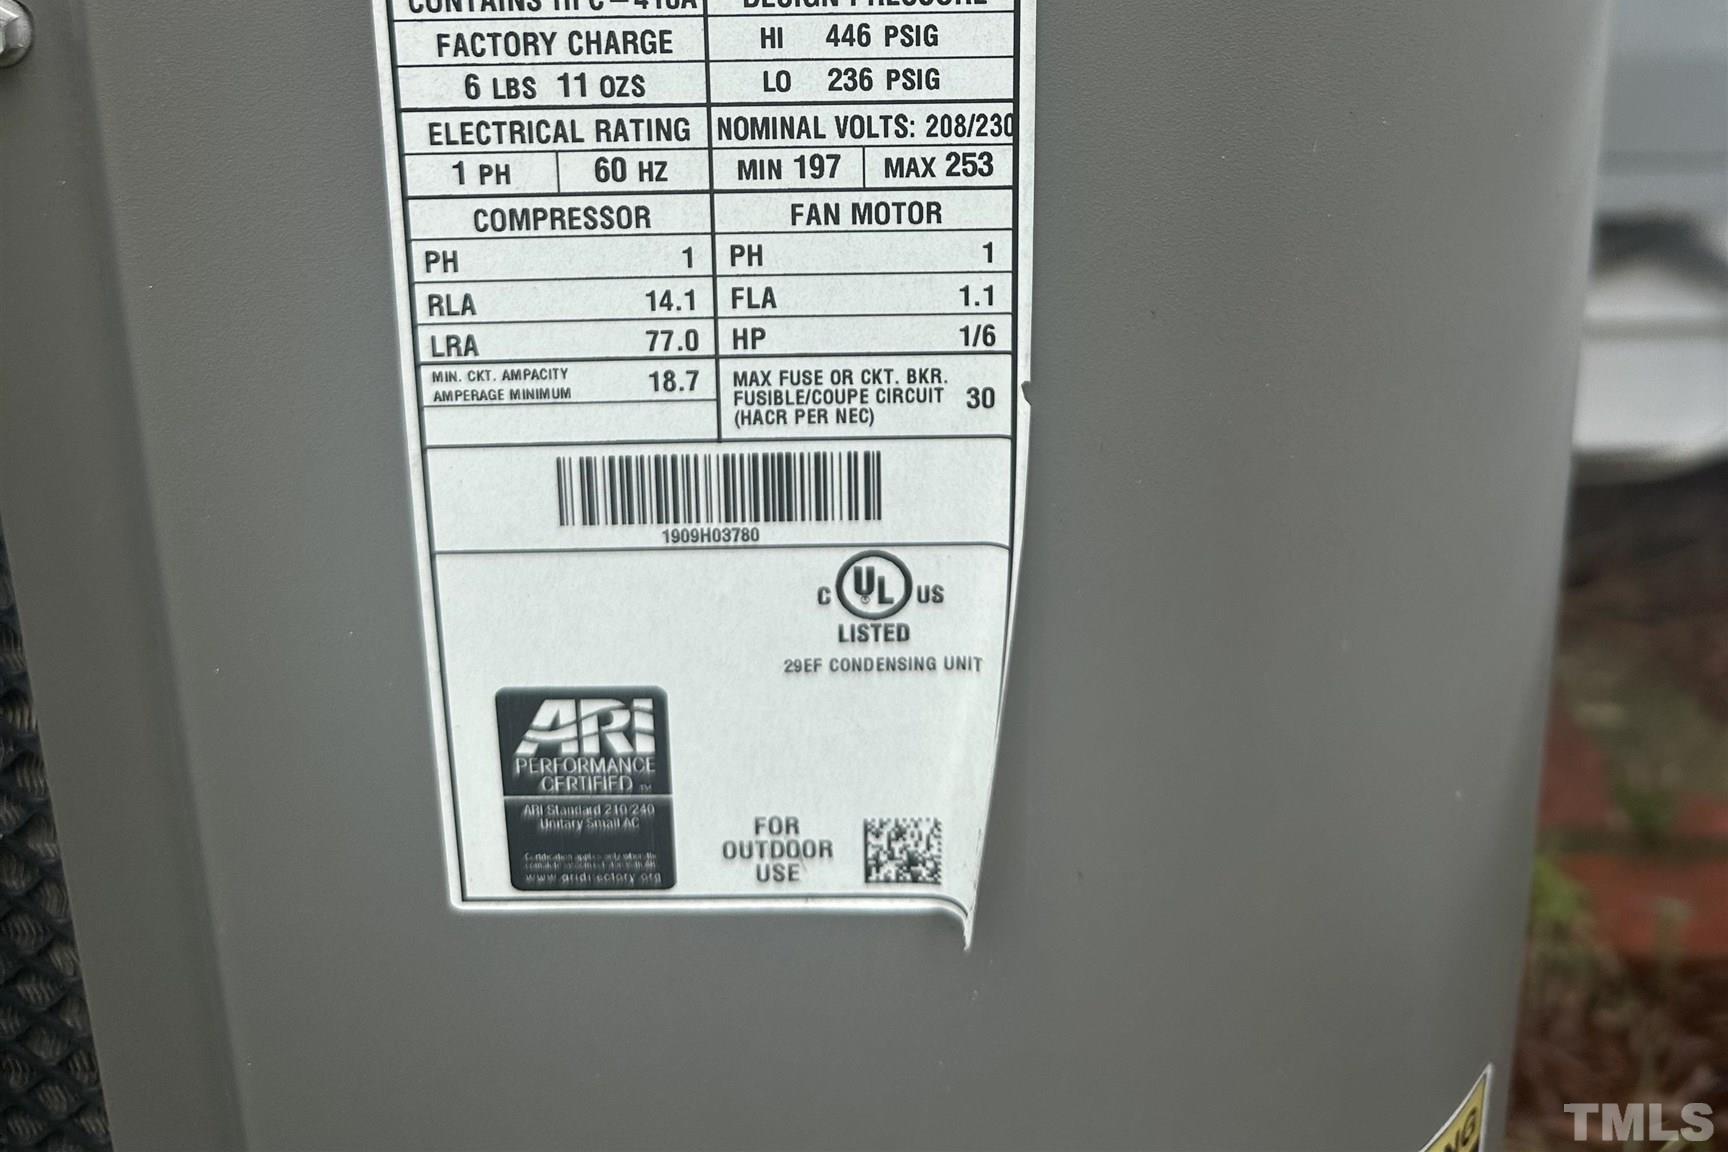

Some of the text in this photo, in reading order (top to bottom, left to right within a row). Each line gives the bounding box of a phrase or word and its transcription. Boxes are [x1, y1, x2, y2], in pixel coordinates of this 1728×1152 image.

[436, 30, 673, 58] FACTORY CHARGE
[760, 23, 939, 49] HI 446 PSIG
[464, 73, 646, 100] 6 LBS 11 OZS
[763, 67, 940, 92] LO 236 PSIG
[429, 117, 691, 146] ELECTRICAL RATING
[717, 113, 1014, 141] NOMINAL VOLTS: 208/230
[452, 160, 511, 186] 1 PH
[593, 158, 668, 183] 60 HZ
[737, 154, 841, 181] MIN 197
[884, 152, 994, 179] MAX 253
[473, 206, 651, 232] COMPRESSOR
[790, 201, 943, 226] FAN MOTOR
[424, 251, 458, 274] PH
[681, 247, 693, 269] 1
[730, 245, 763, 267] PH
[981, 242, 994, 264] 1
[428, 294, 476, 317] RLA
[645, 289, 696, 312] 14.1
[731, 287, 776, 310] FLA
[958, 284, 995, 307] 1.1
[430, 334, 479, 358] LRA
[644, 329, 699, 352] 77.0
[732, 327, 766, 350] HP
[959, 324, 996, 348] 1/6
[431, 367, 569, 382] MIN. CKT. AMPACITY
[649, 369, 699, 393] 18.7
[733, 366, 948, 387] MAX FUSE OR CKT. BKR.
[433, 386, 572, 401] AMPERAGE MINIMUM
[733, 385, 944, 406] FUSIBLE/COUPE CIRCUIT
[966, 386, 996, 411] 30
[733, 406, 875, 428] (HACR PER NEC)
[662, 527, 760, 544] 1909H03780
[917, 585, 944, 603] US
[838, 623, 909, 644] LISTED
[783, 656, 983, 674] 29EF CONDENSING UNIT
[515, 698, 655, 755] ARI
[515, 757, 655, 774] PERFORMANCE
[623, 818, 639, 828] AC
[754, 817, 800, 836] FOR
[722, 840, 833, 860] OUTDOOR
[756, 863, 801, 882] USE
